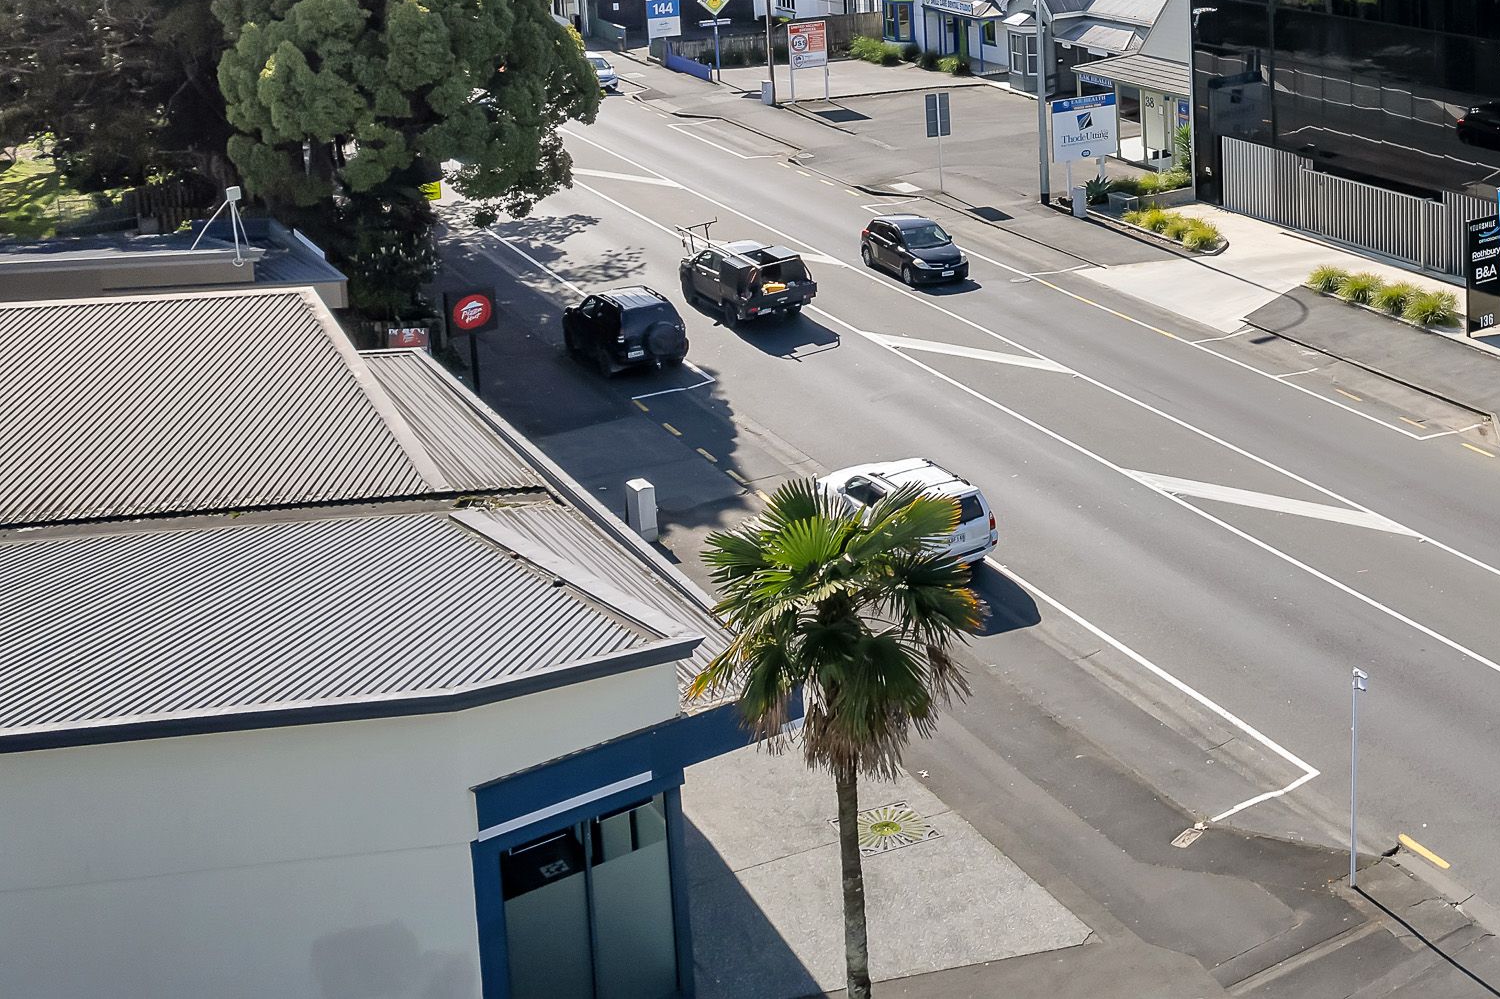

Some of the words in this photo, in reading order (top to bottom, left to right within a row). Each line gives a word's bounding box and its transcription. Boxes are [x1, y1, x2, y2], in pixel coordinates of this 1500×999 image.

[652, 2, 674, 15] 144
[1471, 246, 1500, 260] Rothbury
[1475, 263, 1498, 280] B&A
[461, 307, 483, 320] Pizza
[1480, 313, 1494, 328] 136
